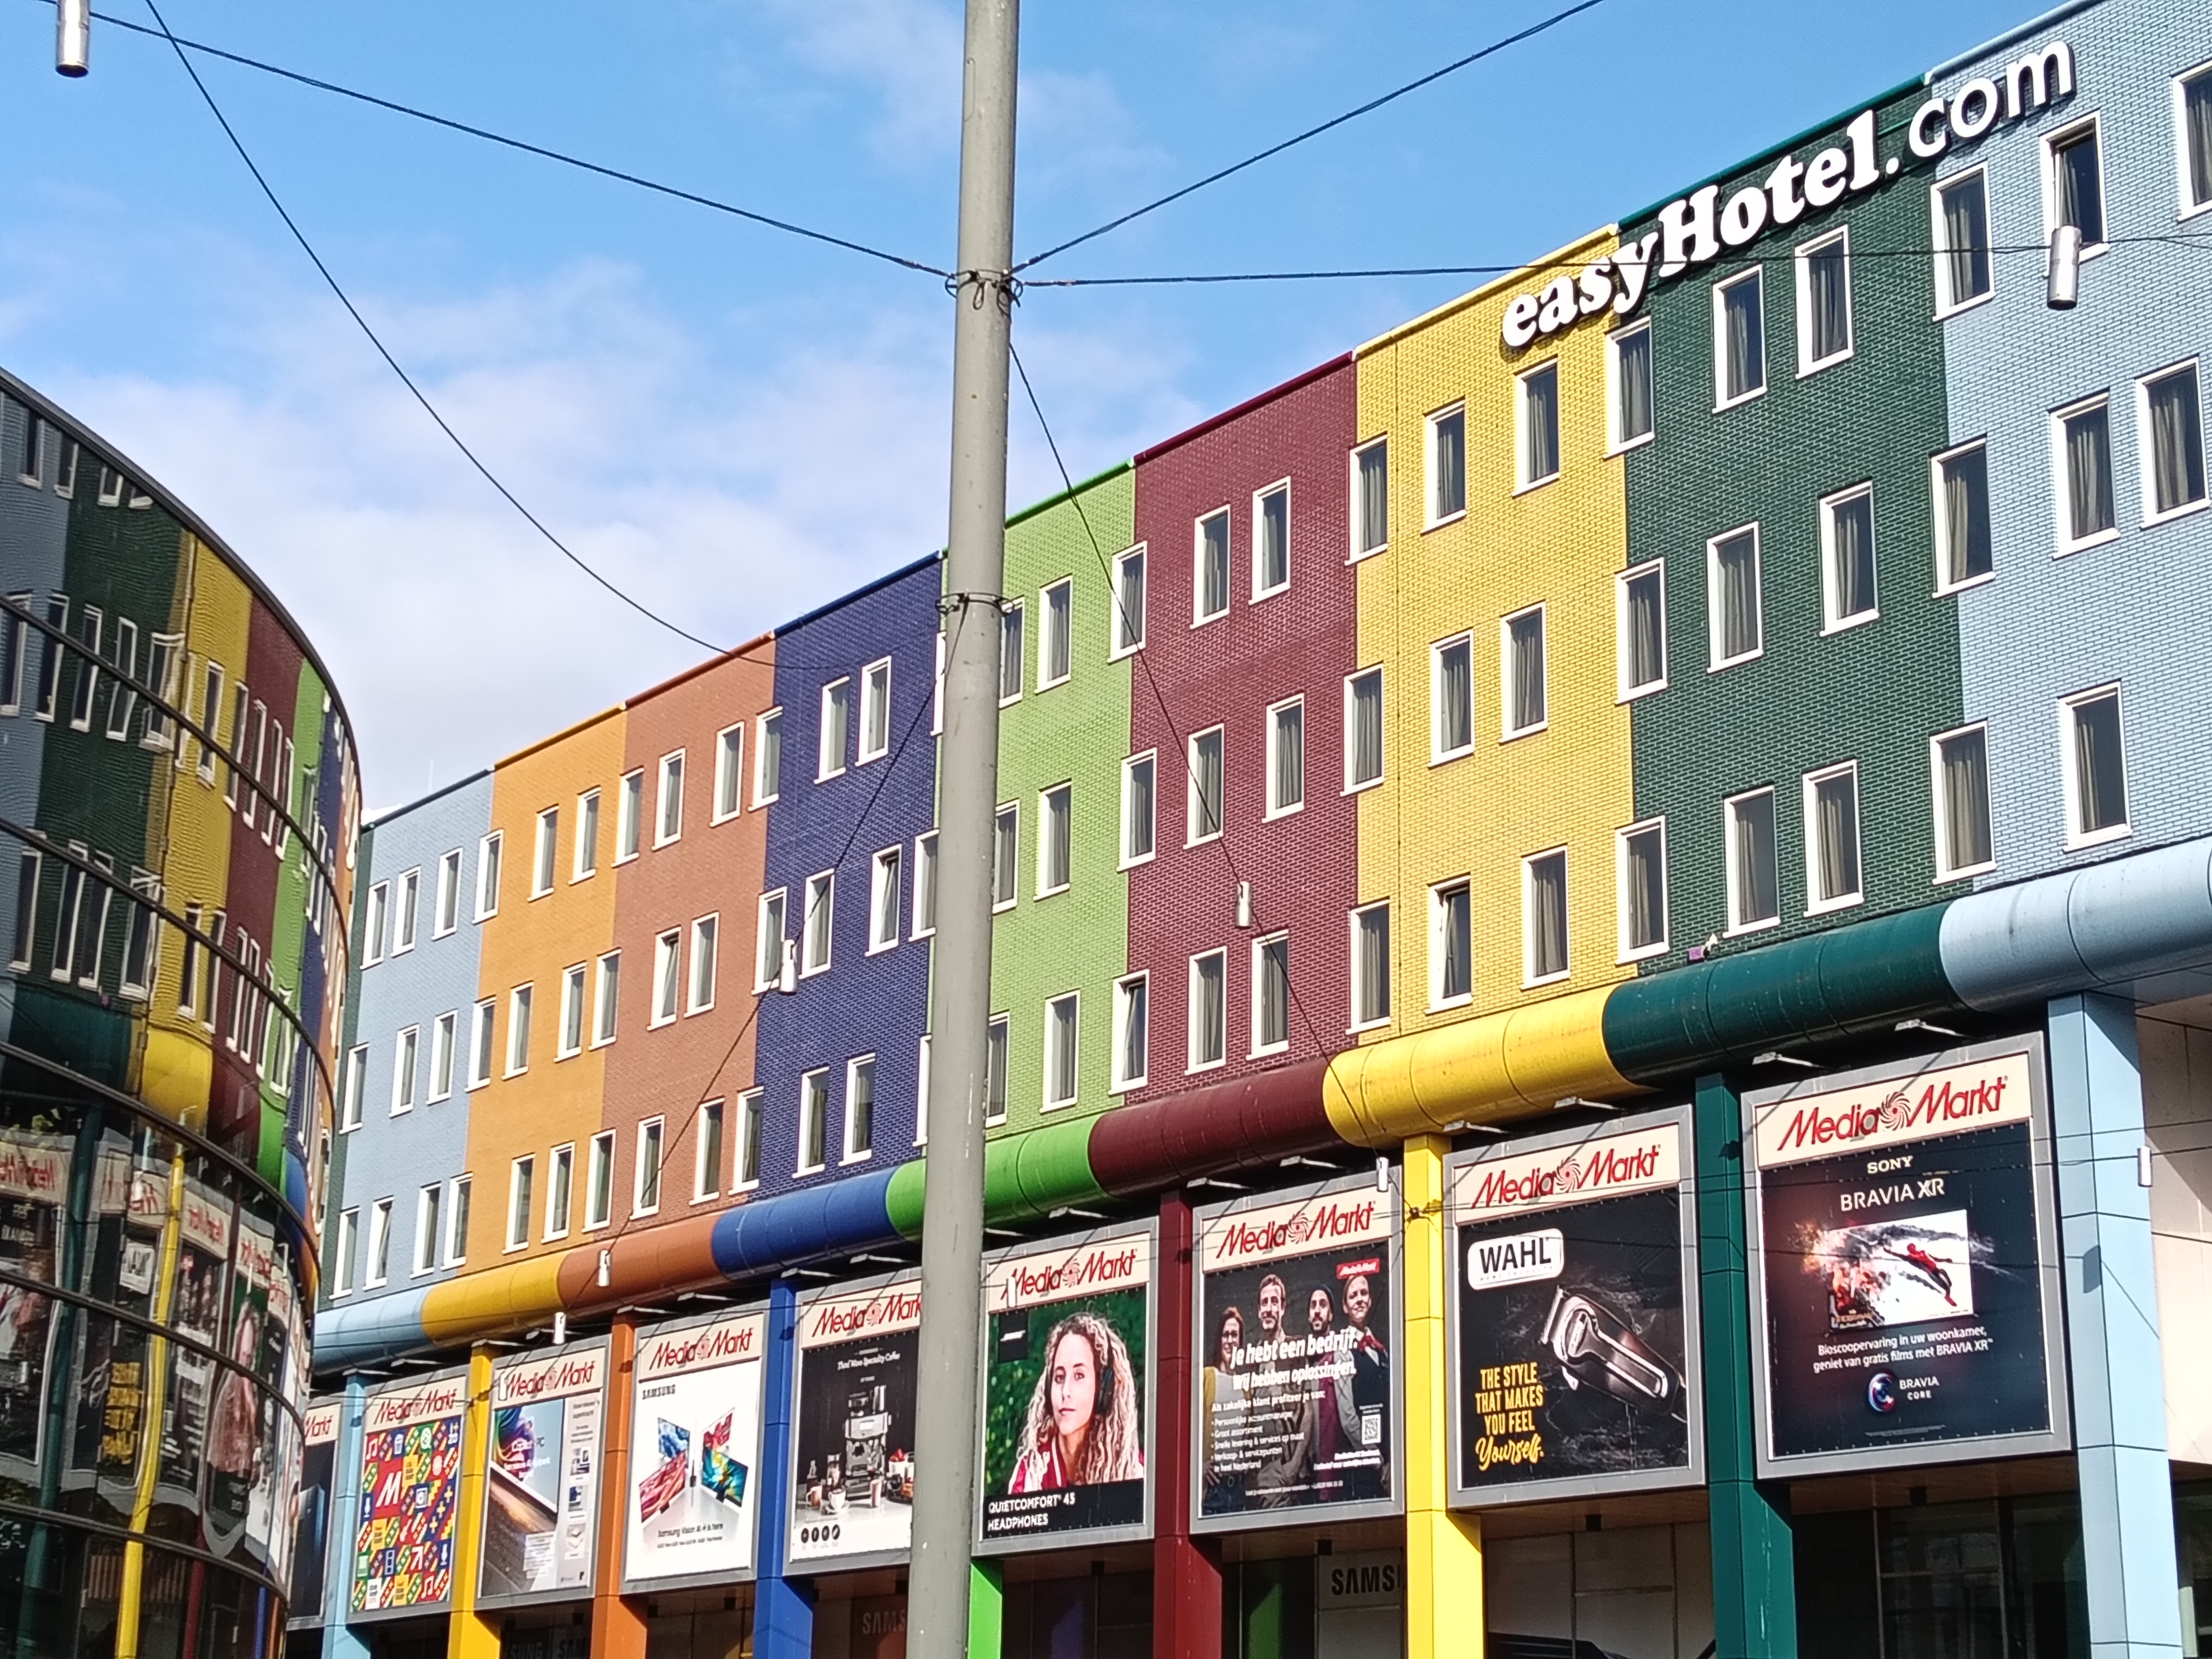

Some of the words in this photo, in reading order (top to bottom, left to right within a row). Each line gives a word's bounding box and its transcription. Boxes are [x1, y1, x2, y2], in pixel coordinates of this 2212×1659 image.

[1501, 39, 2075, 348] easyHotel.com
[1777, 1104, 1880, 1151] Media
[1906, 1077, 2006, 1127] Markt
[1472, 1168, 1556, 1209] Media
[1577, 1145, 1659, 1189] Markt
[1867, 1155, 1913, 1174] SONY
[1840, 1184, 1914, 1211] BRAVIA
[1917, 1178, 1945, 1199] XR
[1216, 1221, 1288, 1258] Media
[1305, 1201, 1374, 1242] Markt
[1479, 1237, 1552, 1273] WAHL
[1000, 1266, 1063, 1300] Media
[1077, 1249, 1136, 1285] Markt
[812, 1306, 867, 1338] Media
[879, 1293, 922, 1324] Mark
[649, 1341, 697, 1371] Media
[707, 1328, 752, 1358] Markt
[1245, 1340, 1278, 1364] hebt
[1279, 1339, 1305, 1359] een
[1813, 1358, 1843, 1373] geniet
[1844, 1357, 1861, 1368] van
[1863, 1352, 1889, 1367] gratis
[1891, 1350, 1913, 1361] films
[1915, 1347, 1935, 1359] met
[1937, 1341, 1973, 1356] BRAVIA
[1818, 1337, 1897, 1356] Bioscoopervaring
[1899, 1334, 1909, 1346] in
[1911, 1335, 1925, 1344] uw
[1251, 1368, 1290, 1388] hebben
[1480, 1368, 1500, 1390] THE
[1503, 1362, 1538, 1387] STYLE
[1899, 1376, 1939, 1390] BRAVIA
[642, 1384, 676, 1400] SAMSUNG
[1475, 1388, 1503, 1414] THAT
[1505, 1384, 1543, 1410] MAKES
[1907, 1390, 1932, 1400] CORE
[1484, 1413, 1506, 1436] YOU
[1509, 1410, 1535, 1433] FEEL
[1063, 1492, 1075, 1505] 45
[987, 1513, 1048, 1531] HEADPHONES
[1331, 1564, 1400, 1595] SAMS
